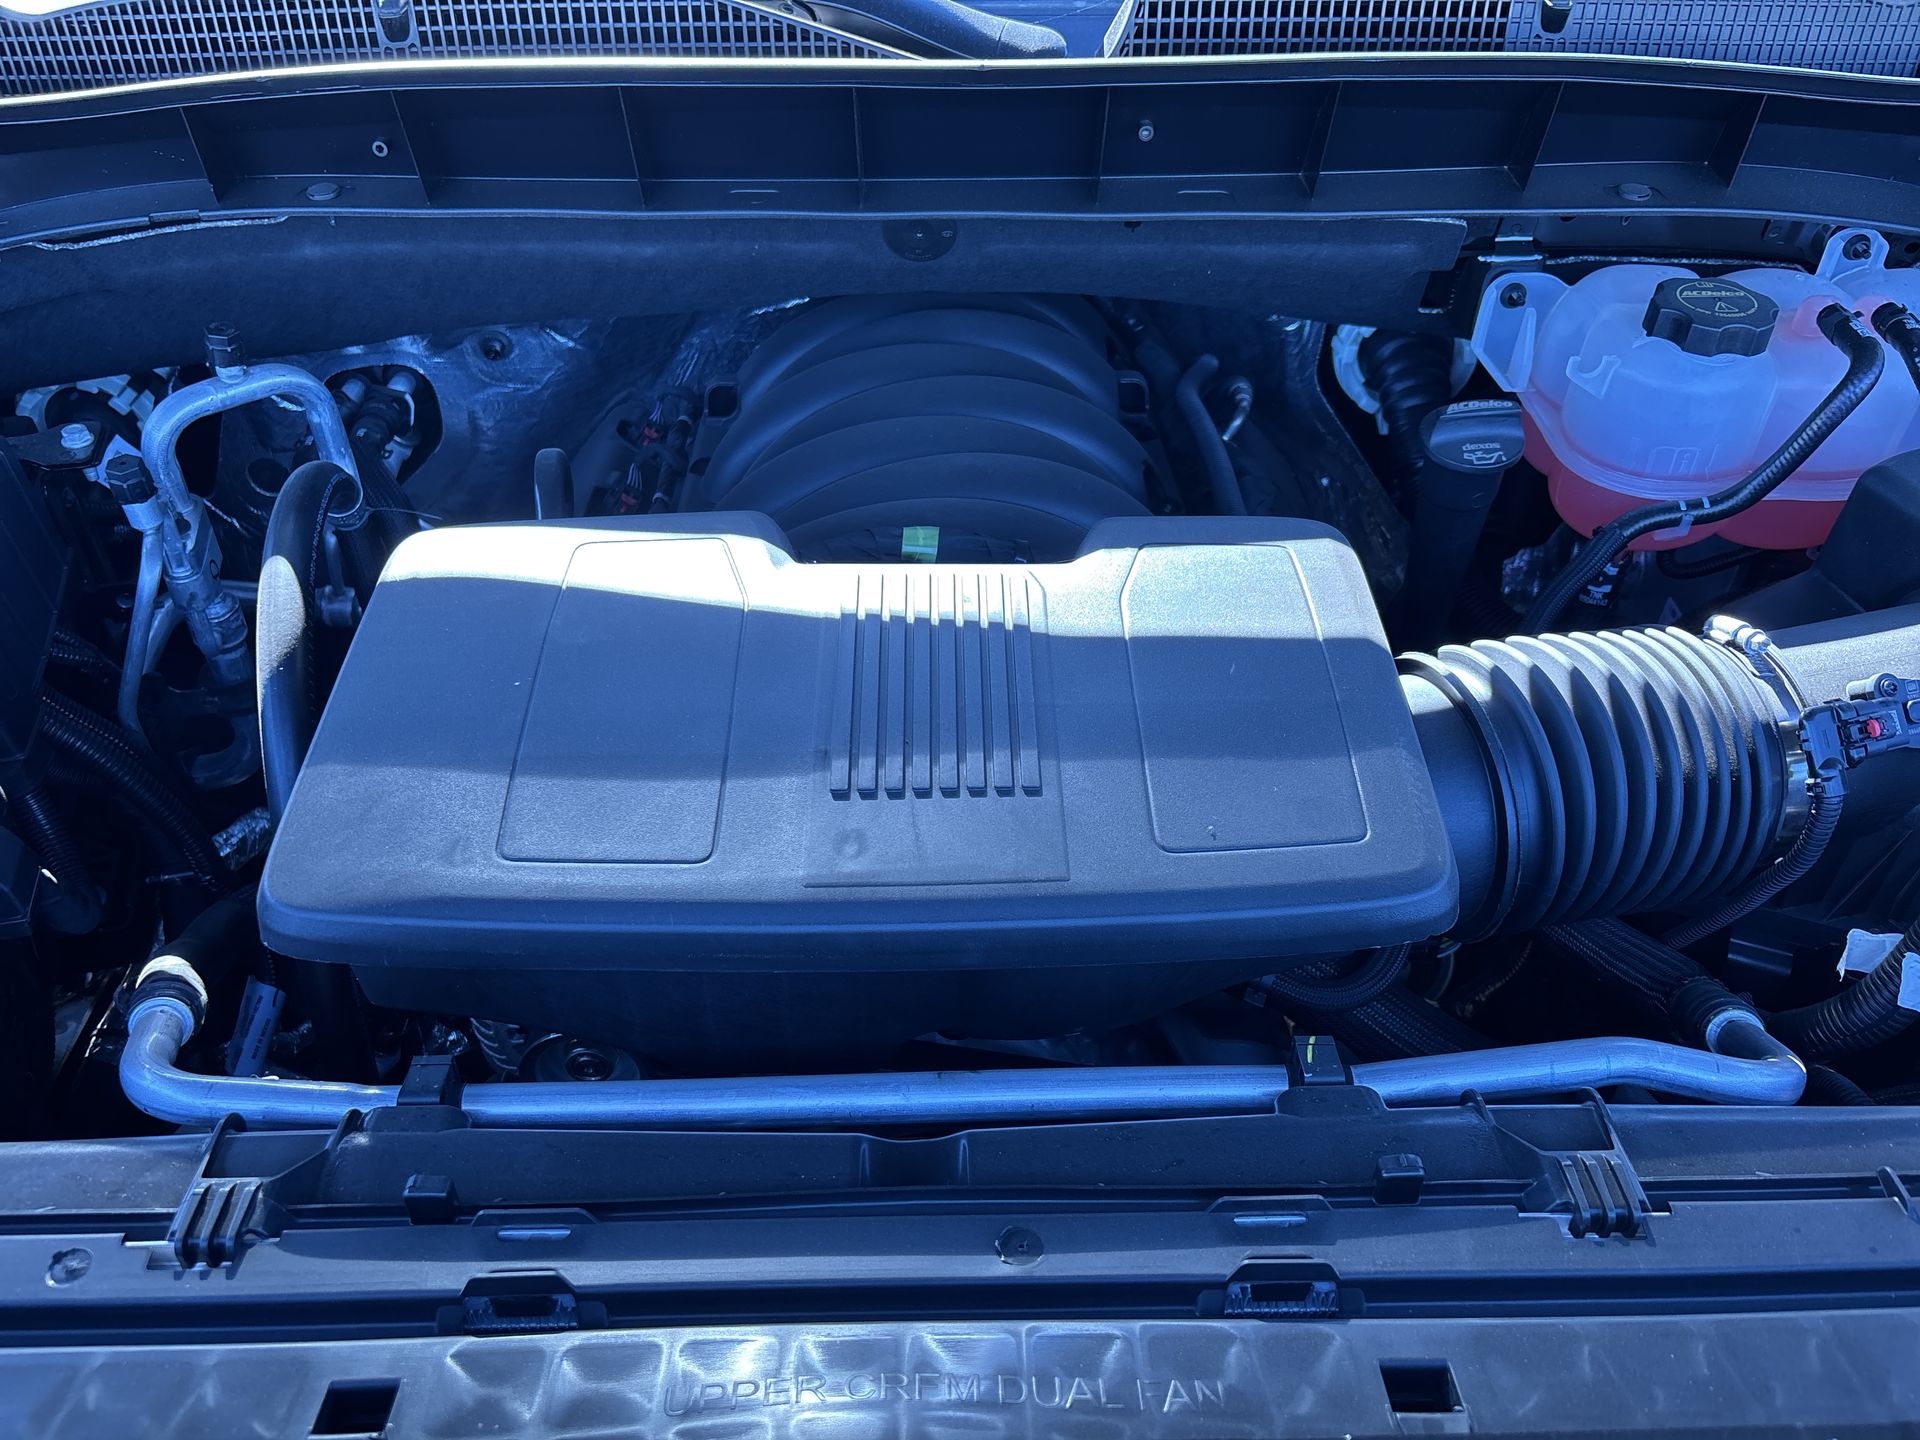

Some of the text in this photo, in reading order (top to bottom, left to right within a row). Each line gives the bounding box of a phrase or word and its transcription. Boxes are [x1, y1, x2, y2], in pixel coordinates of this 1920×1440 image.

[1681, 289, 1745, 298] ACDelco
[1446, 400, 1513, 413] ACDelco
[1462, 443, 1501, 451] dexos
[664, 1372, 1224, 1417] UPPER CRFM DUAL FAN
